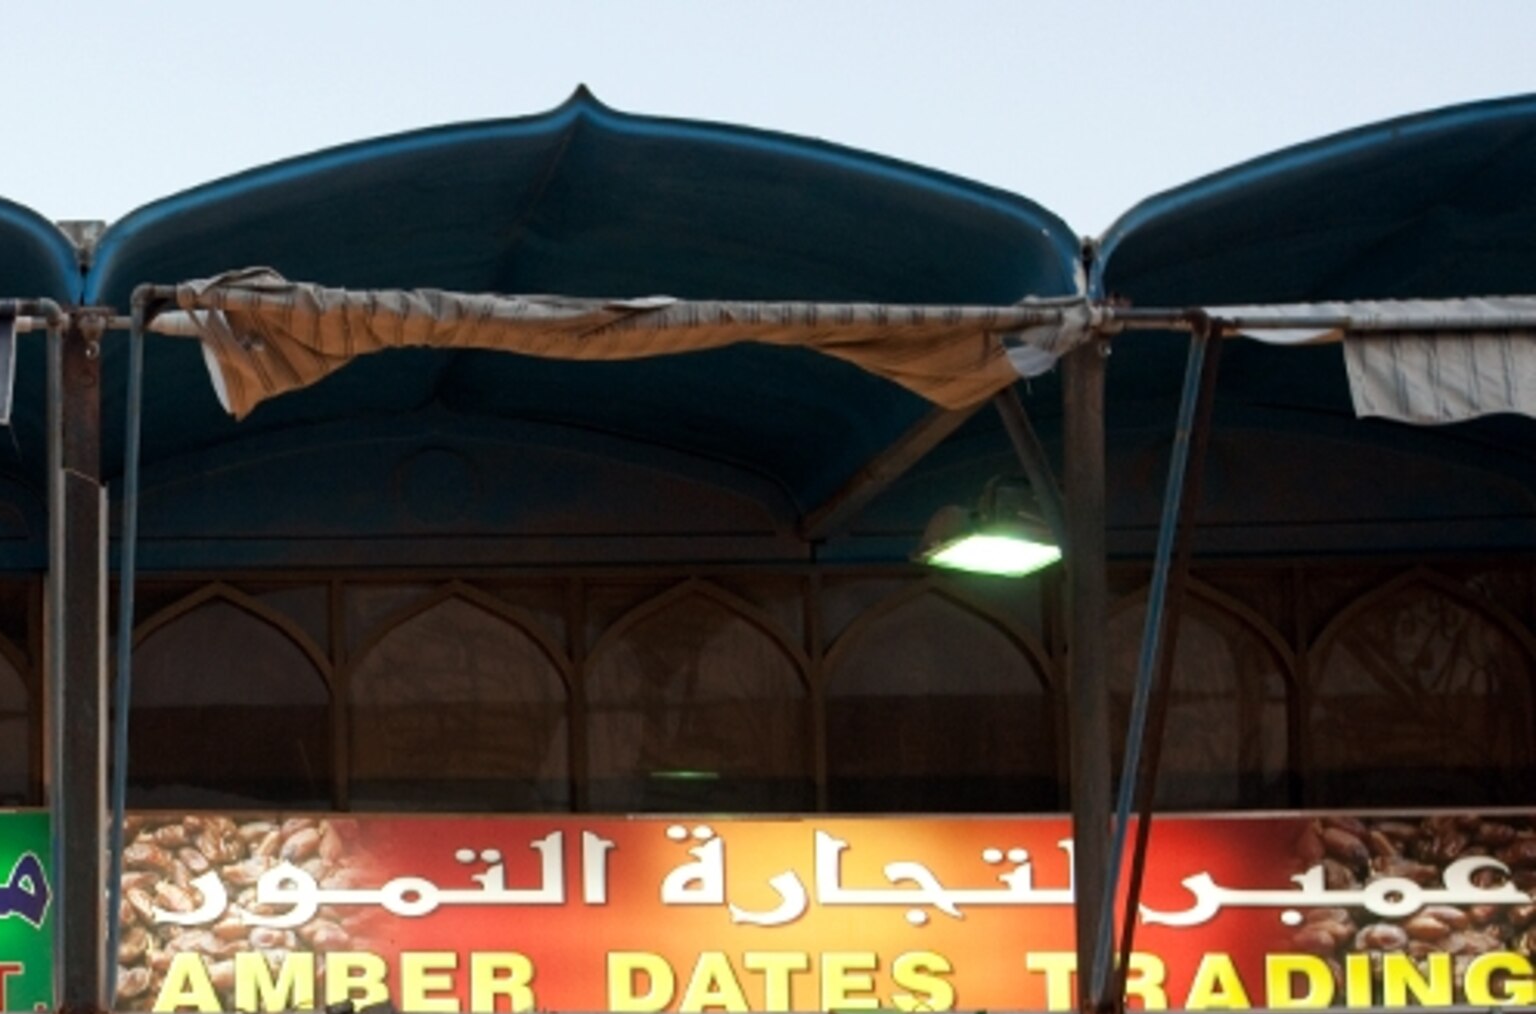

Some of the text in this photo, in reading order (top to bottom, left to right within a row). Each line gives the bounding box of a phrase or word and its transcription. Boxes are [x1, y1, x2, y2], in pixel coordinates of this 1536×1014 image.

[152, 830, 616, 929] التمور
[150, 950, 1536, 1014] AMBER DATES TRADING
